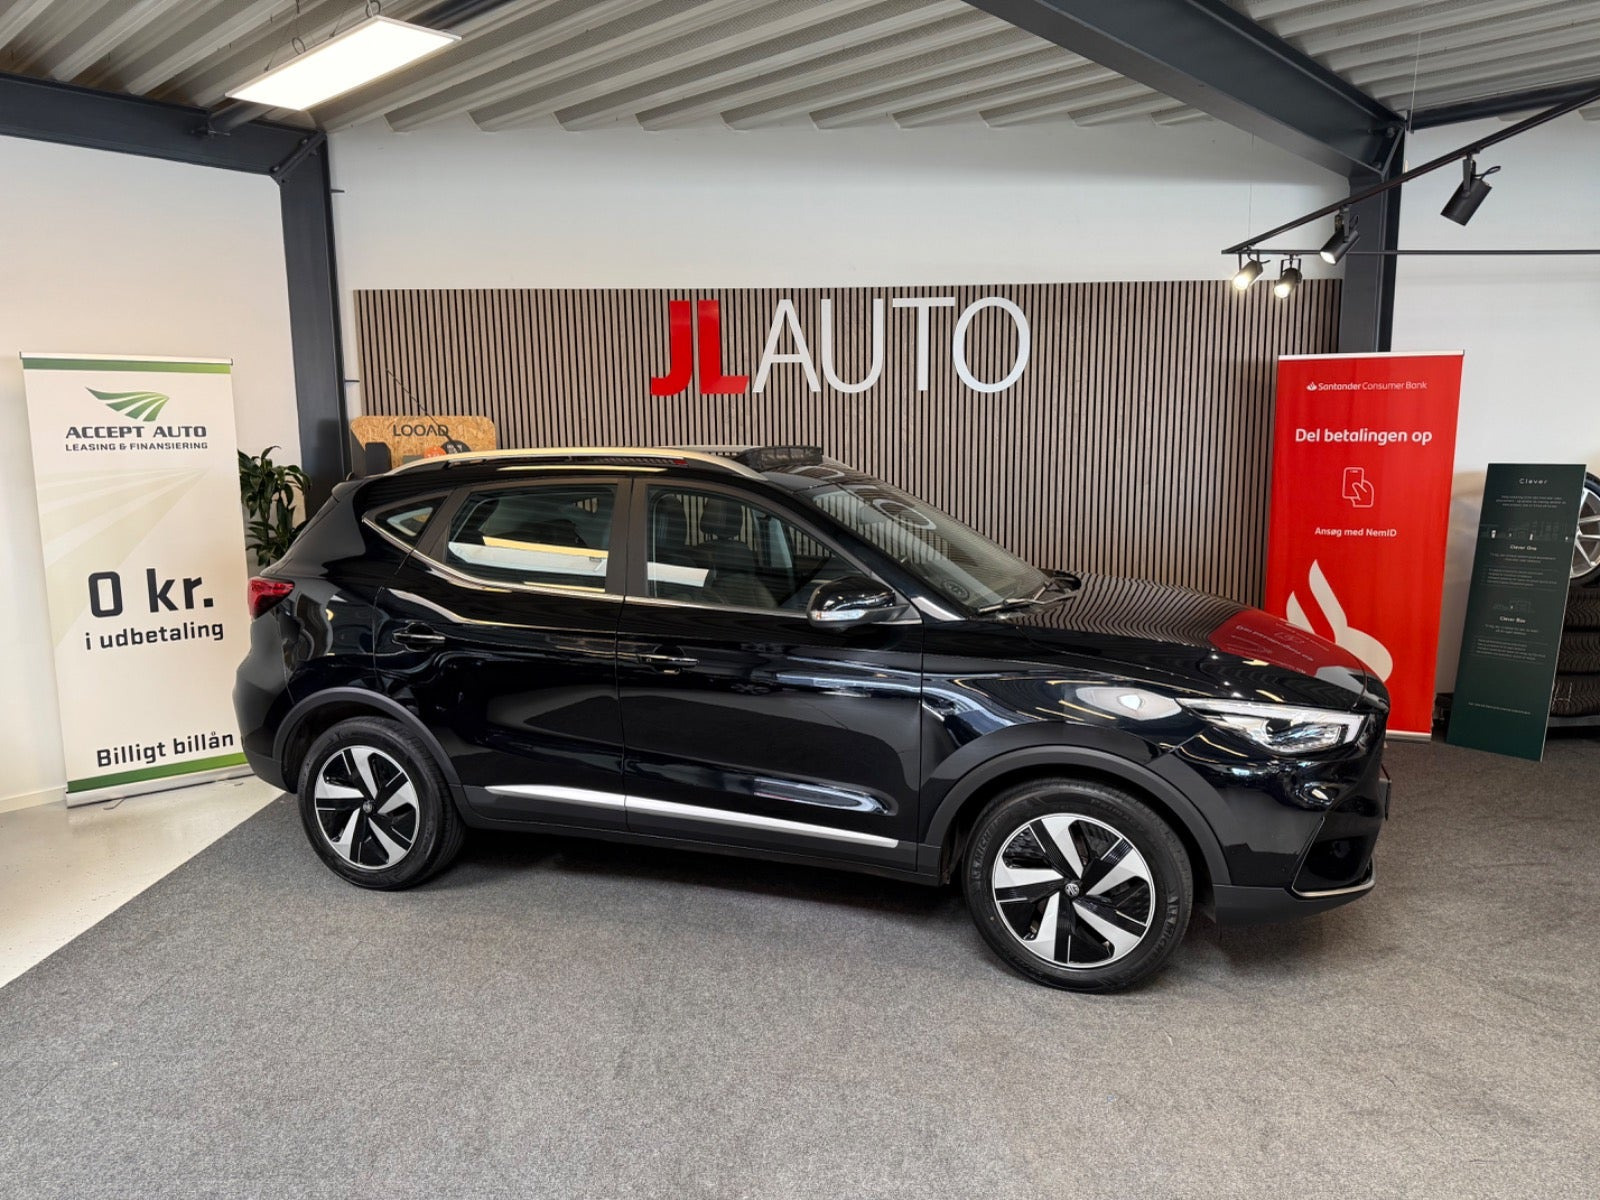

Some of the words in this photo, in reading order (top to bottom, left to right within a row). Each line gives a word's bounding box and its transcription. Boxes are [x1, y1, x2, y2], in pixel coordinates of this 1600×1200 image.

[1318, 382, 1361, 391] Santander
[1362, 381, 1404, 391] Consumer
[1405, 381, 1428, 390] Bank
[65, 426, 145, 439] ACCEPT
[152, 426, 208, 438] AUTO
[1295, 428, 1321, 442] Del
[1323, 427, 1408, 446] betalingen
[1411, 431, 1433, 446] op
[65, 443, 117, 452] LEASING
[119, 443, 127, 451] &
[129, 442, 209, 451] FINANSIERING
[1314, 526, 1342, 538] Ansøg
[1344, 527, 1364, 537] med
[1365, 527, 1398, 538] NemID
[146, 567, 214, 613] kr.
[85, 632, 92, 651] i
[99, 621, 224, 649] udbetaling
[96, 742, 167, 768] Billigt
[172, 730, 235, 756] billån
